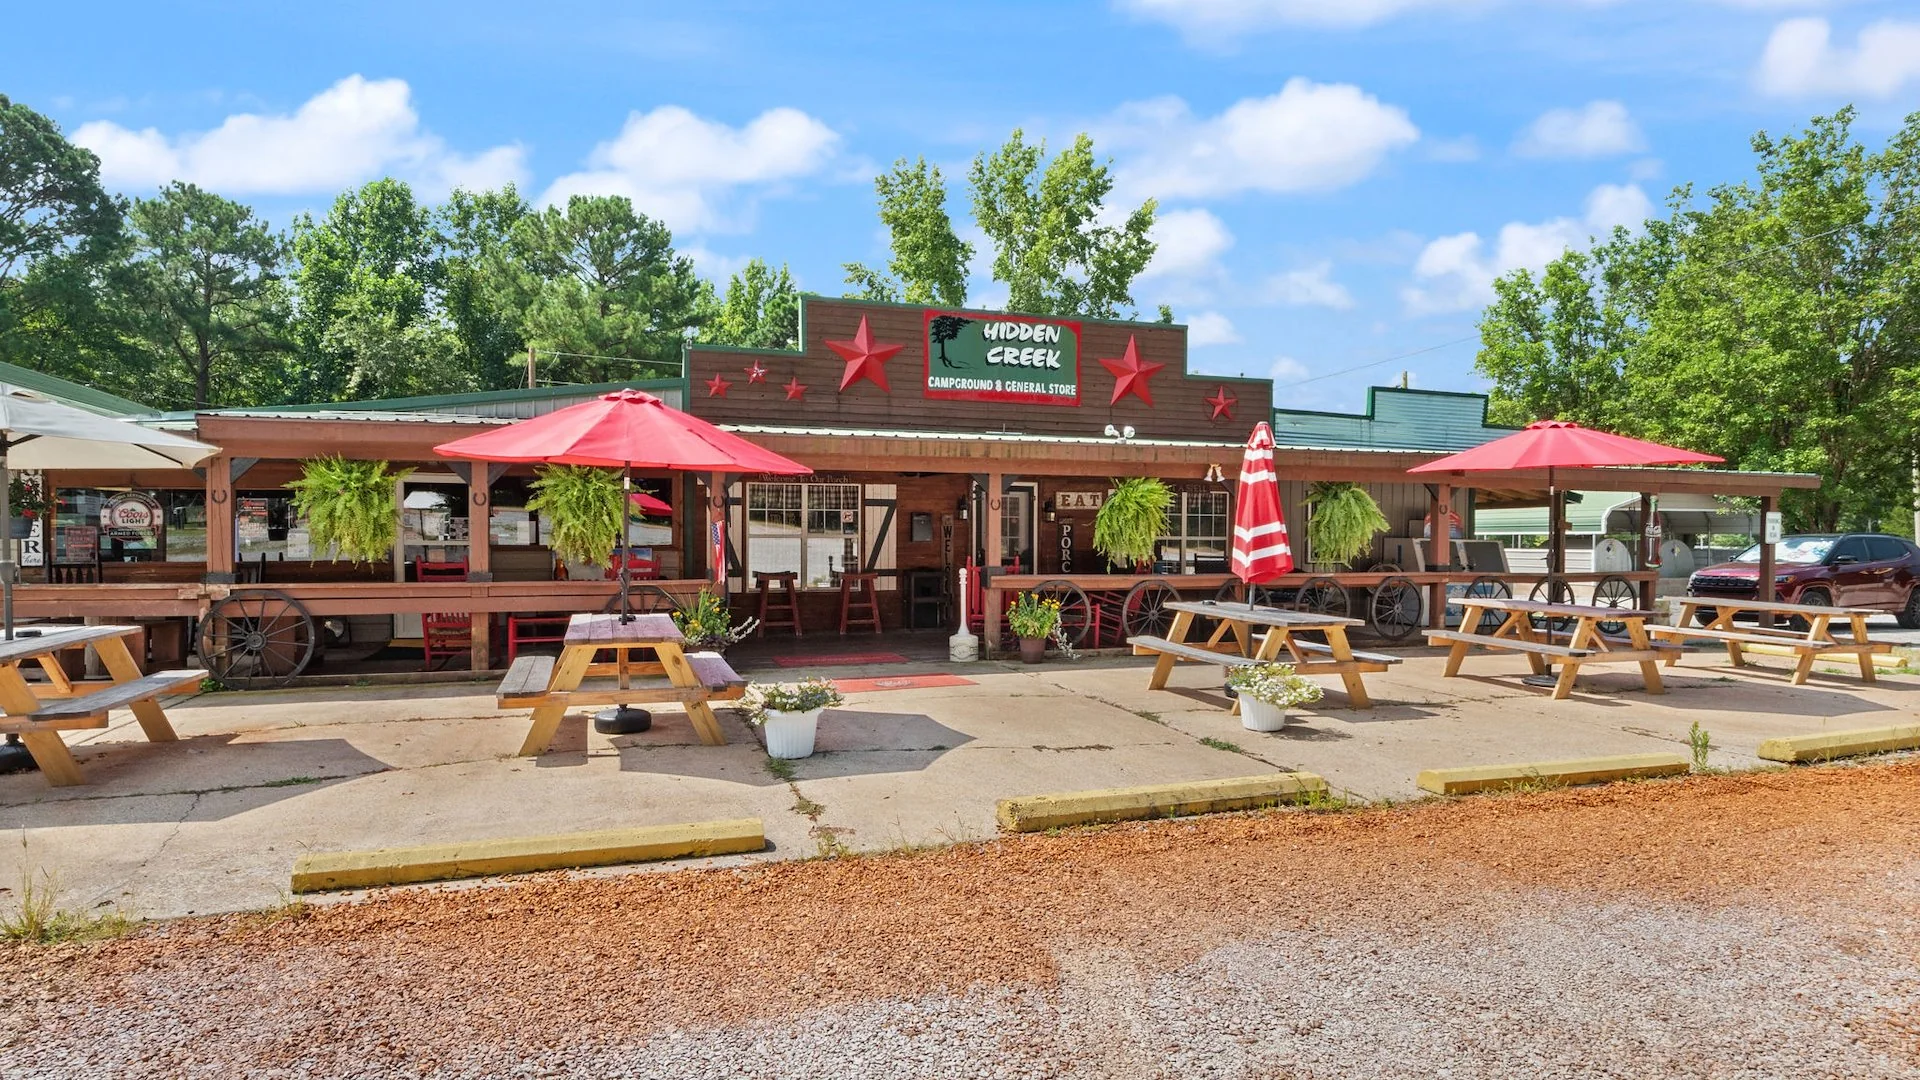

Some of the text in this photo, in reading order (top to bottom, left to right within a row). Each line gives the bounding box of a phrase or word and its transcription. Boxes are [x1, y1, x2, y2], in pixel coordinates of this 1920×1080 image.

[983, 321, 1061, 344] HIDDEN
[986, 346, 1061, 369] CREEK
[928, 376, 993, 391] CAMPGROUND
[1005, 380, 1047, 394] GENERAL
[1048, 383, 1076, 396] STORE
[1060, 494, 1100, 507] EAT
[118, 508, 149, 518] Coors
[1060, 524, 1072, 573] PORC
[23, 554, 40, 564] here
